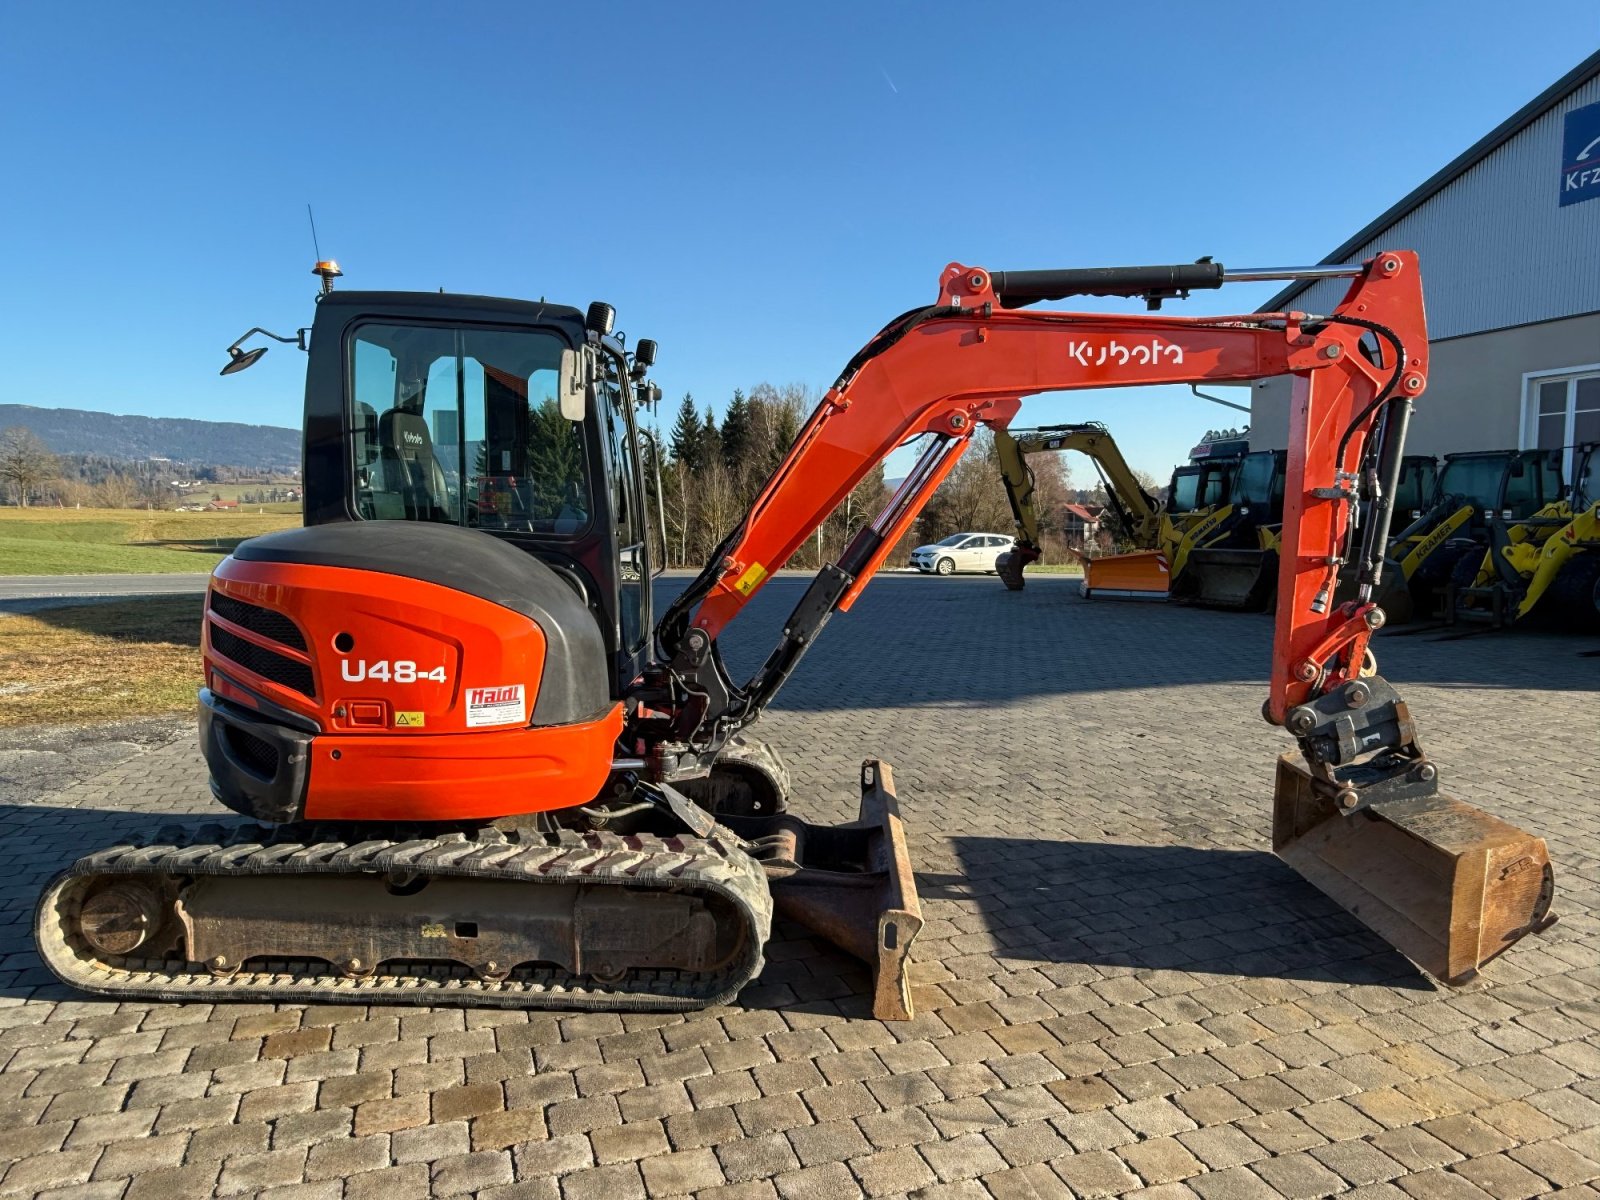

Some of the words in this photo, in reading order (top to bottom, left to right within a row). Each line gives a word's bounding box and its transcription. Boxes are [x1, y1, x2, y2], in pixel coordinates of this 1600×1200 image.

[1069, 340, 1183, 366] Kubota
[1415, 523, 1452, 559] KRAMER
[342, 659, 447, 684] U48-4
[471, 686, 520, 704] Haidl
